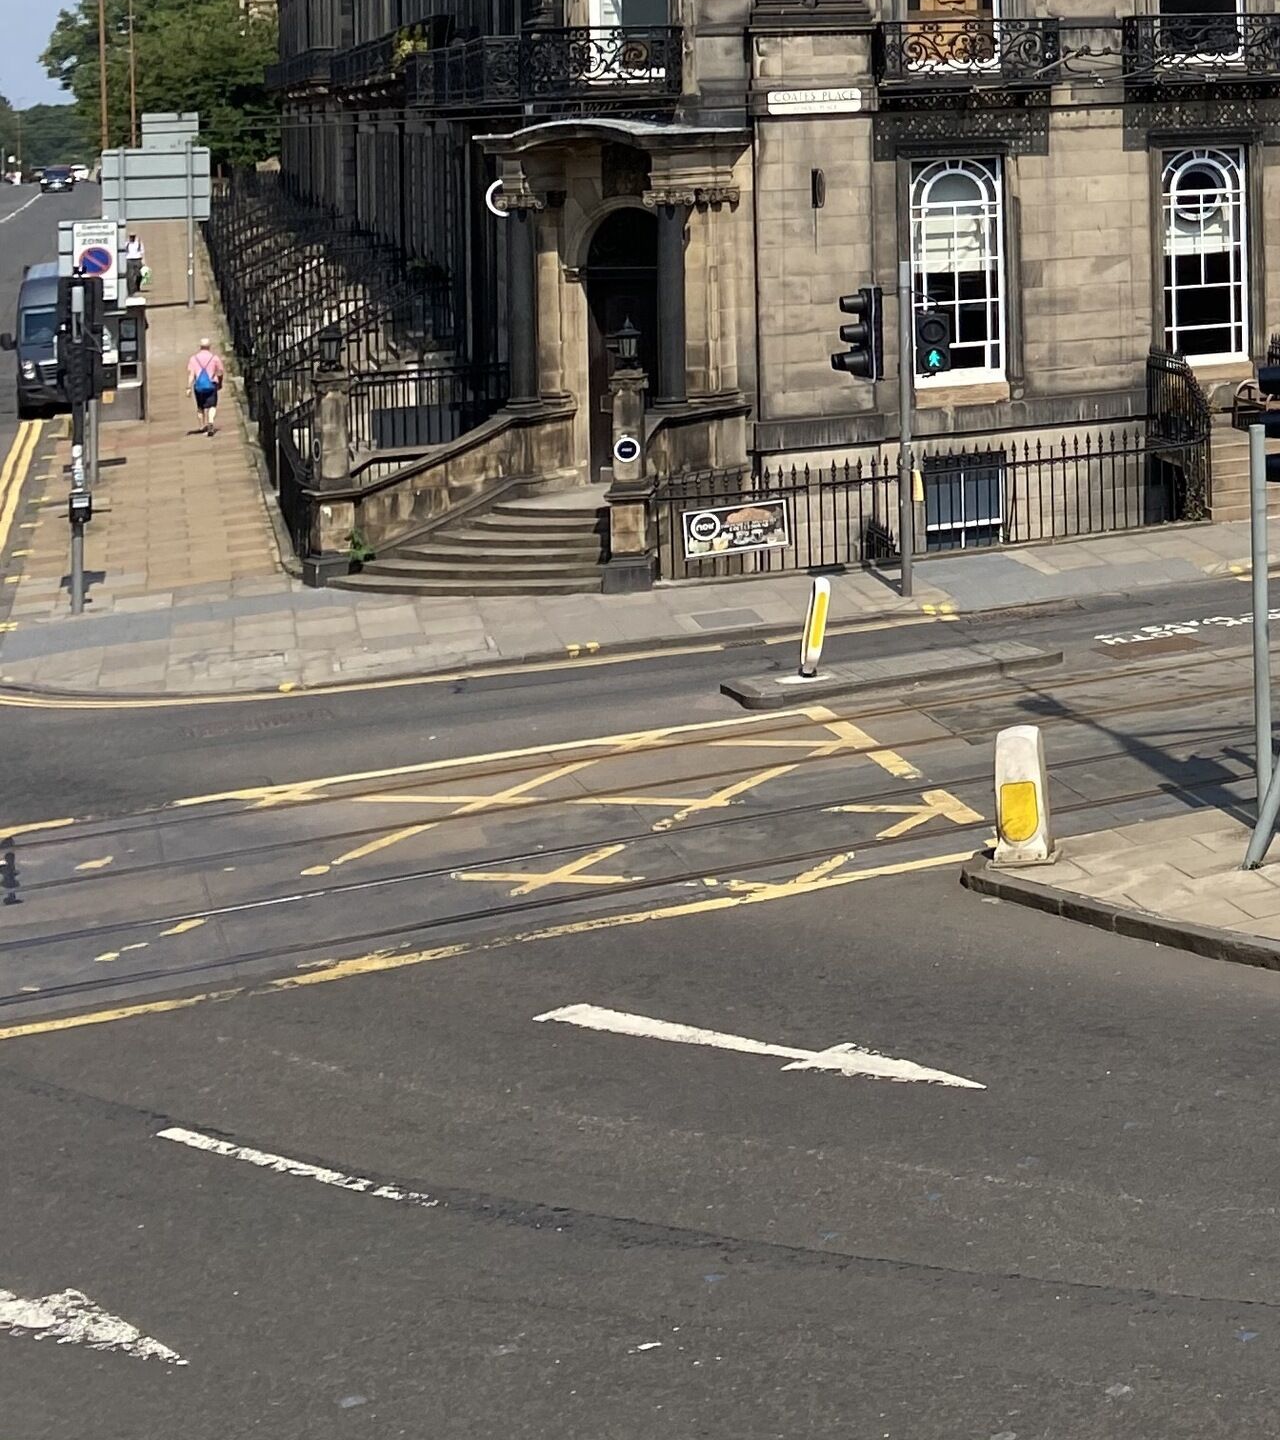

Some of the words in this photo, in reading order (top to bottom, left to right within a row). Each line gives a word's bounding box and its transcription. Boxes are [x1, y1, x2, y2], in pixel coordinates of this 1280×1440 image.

[774, 92, 816, 102] COATES
[822, 90, 855, 100] PLACE
[1102, 626, 1199, 645] BOTH
